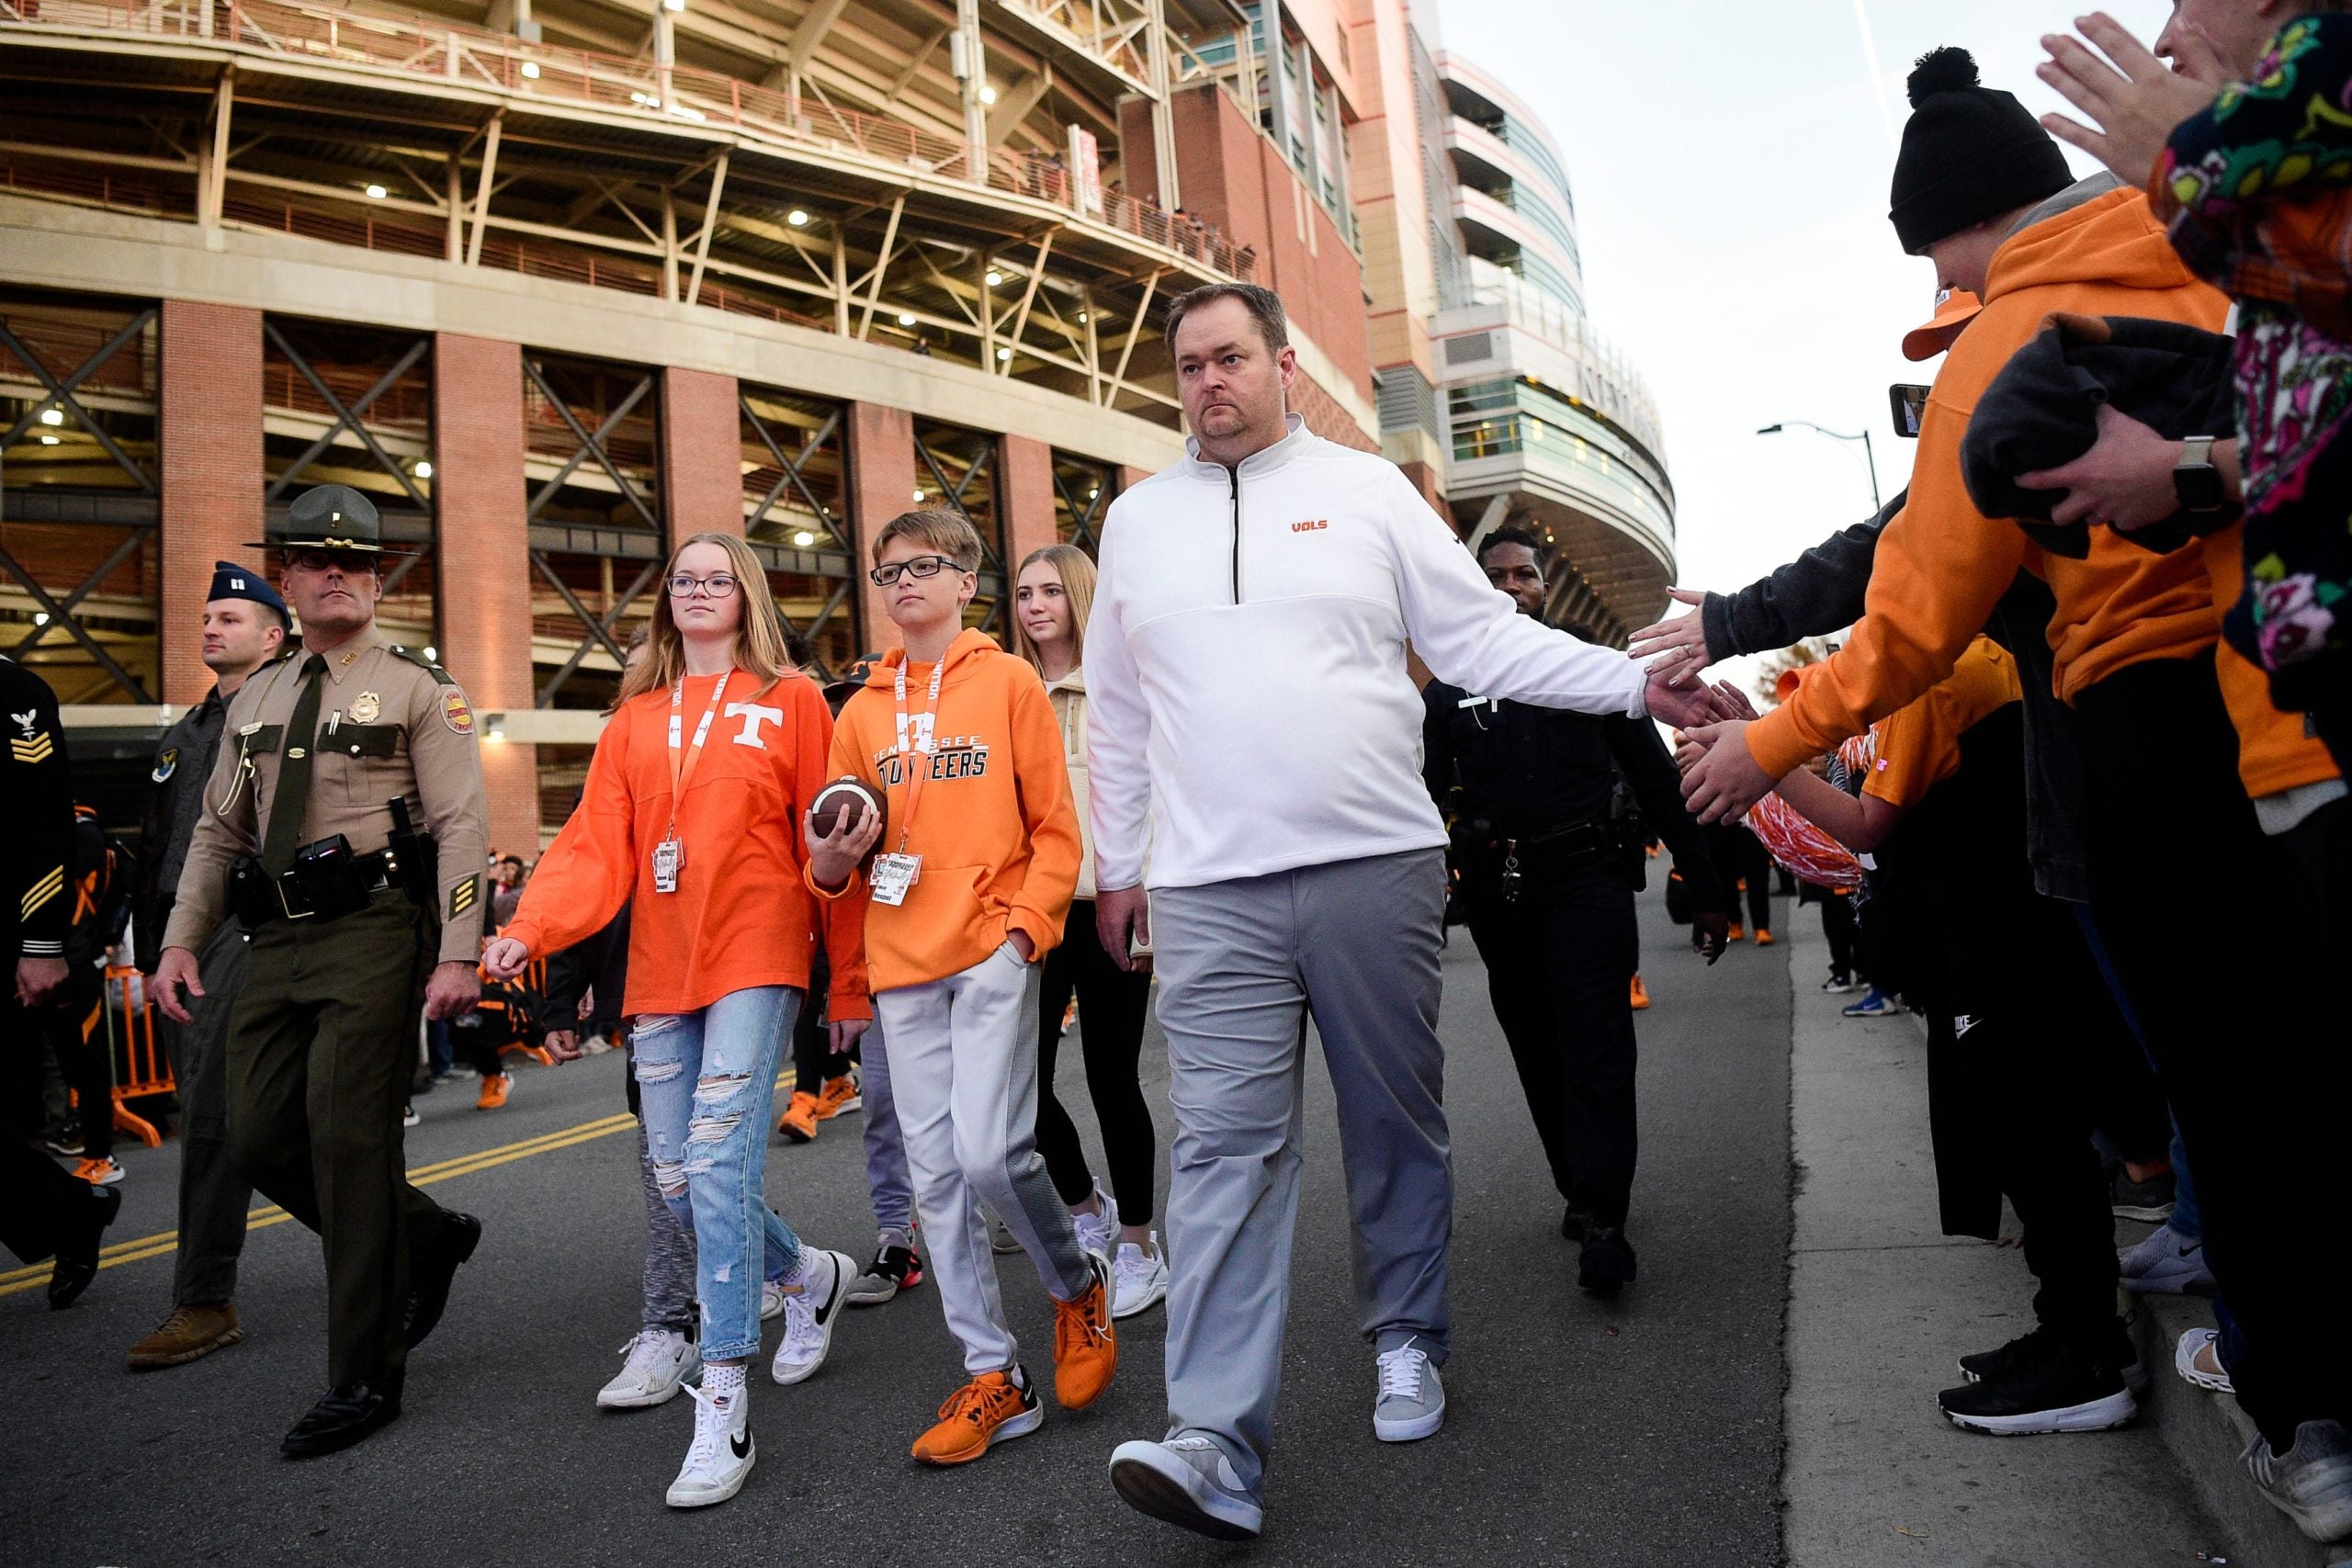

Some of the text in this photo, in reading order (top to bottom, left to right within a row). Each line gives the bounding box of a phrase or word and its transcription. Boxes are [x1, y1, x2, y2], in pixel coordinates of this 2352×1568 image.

[1291, 519, 1329, 533] VOLS
[724, 702, 784, 750] T
[873, 736, 982, 761] TENSSEE
